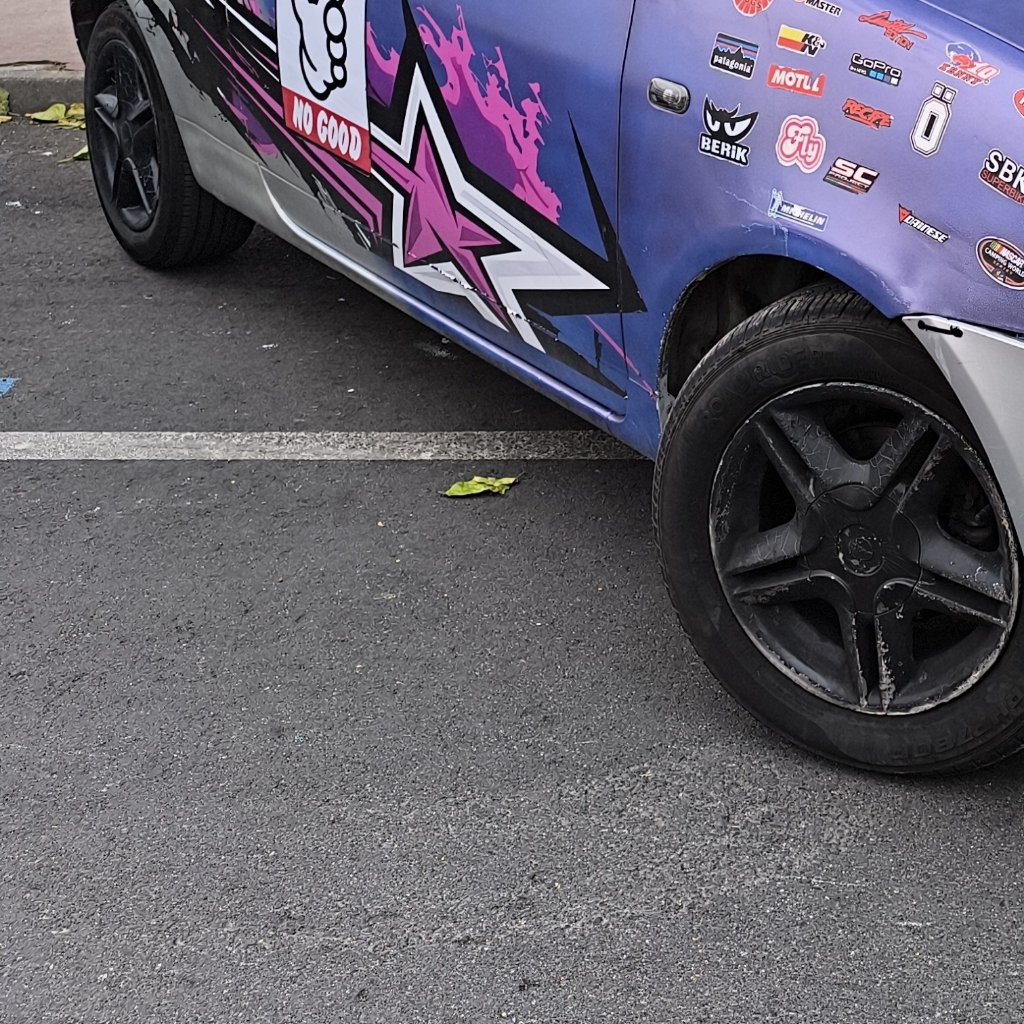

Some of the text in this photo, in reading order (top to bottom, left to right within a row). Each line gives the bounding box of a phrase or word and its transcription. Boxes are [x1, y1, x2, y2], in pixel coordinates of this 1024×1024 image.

[713, 54, 753, 74] patagonia
[852, 53, 901, 78] GoPro
[292, 95, 362, 161] NO GOOD
[782, 124, 819, 163] Fly
[830, 158, 879, 186] SC
[903, 215, 949, 243] DAINESE
[984, 247, 1008, 266] CAMPING
